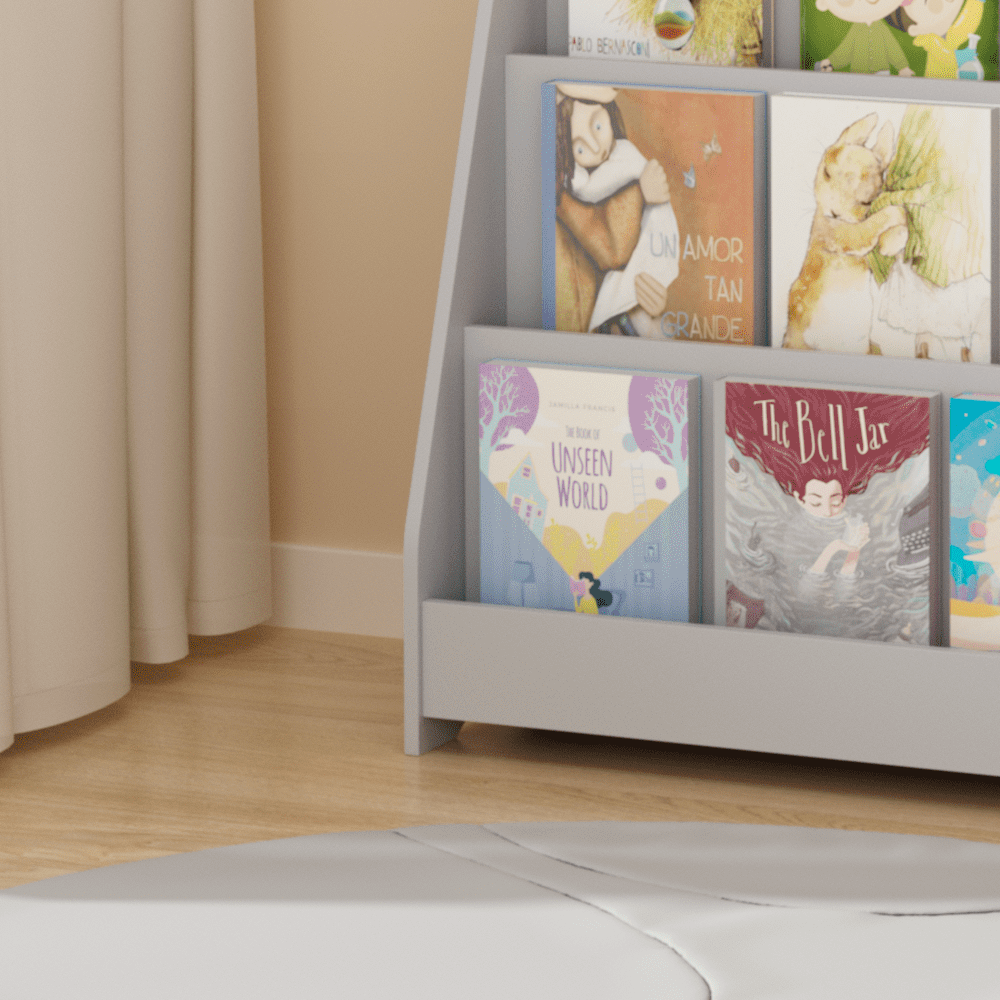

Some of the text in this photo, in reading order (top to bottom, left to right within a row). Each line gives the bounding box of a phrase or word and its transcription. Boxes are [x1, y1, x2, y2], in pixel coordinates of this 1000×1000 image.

[650, 232, 744, 264] UN AMOR
[703, 274, 743, 304] TAN
[660, 311, 744, 343] GRANDE
[753, 398, 890, 472] The Bell Jar
[551, 441, 613, 478] UNSEEN
[556, 475, 610, 512] WORLD
